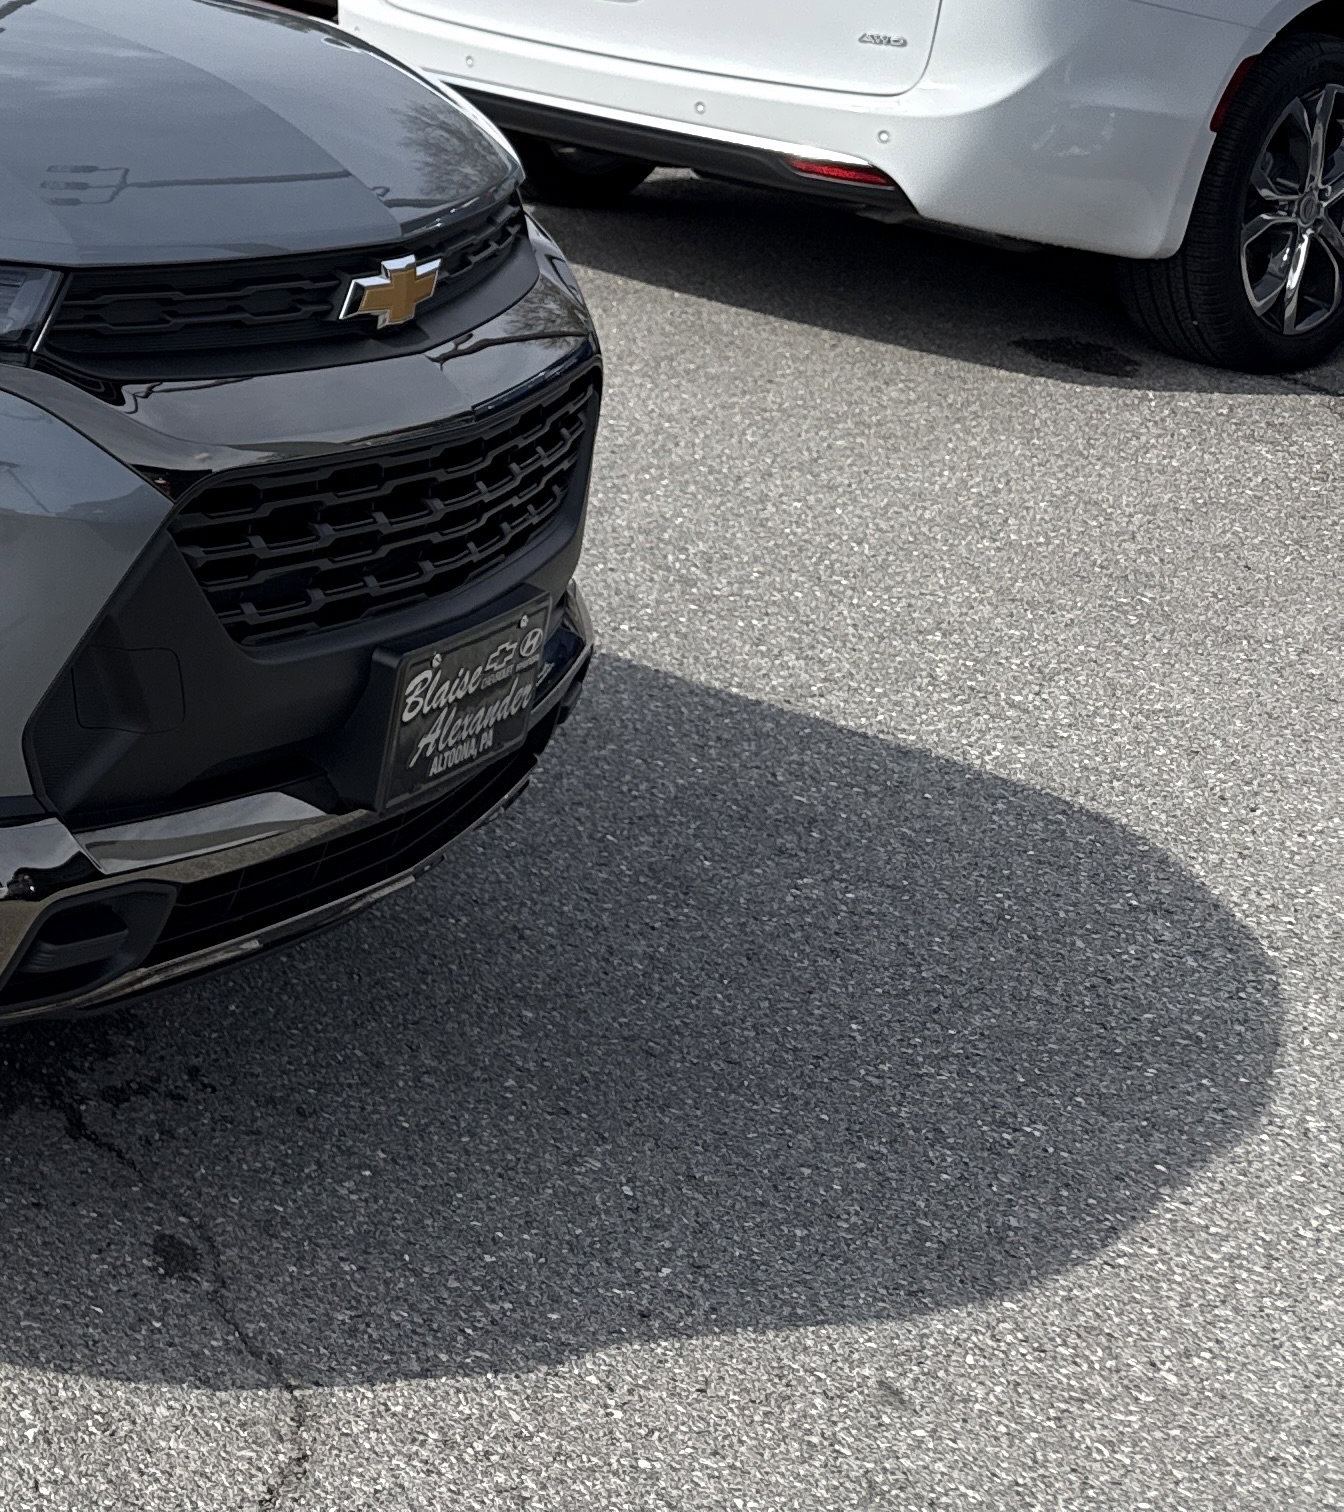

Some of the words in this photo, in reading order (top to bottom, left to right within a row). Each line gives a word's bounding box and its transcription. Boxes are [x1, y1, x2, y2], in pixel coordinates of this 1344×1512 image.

[858, 33, 908, 48] AWD
[401, 665, 483, 723] Blaise
[409, 676, 533, 768] Alexander
[479, 728, 494, 752] PA
